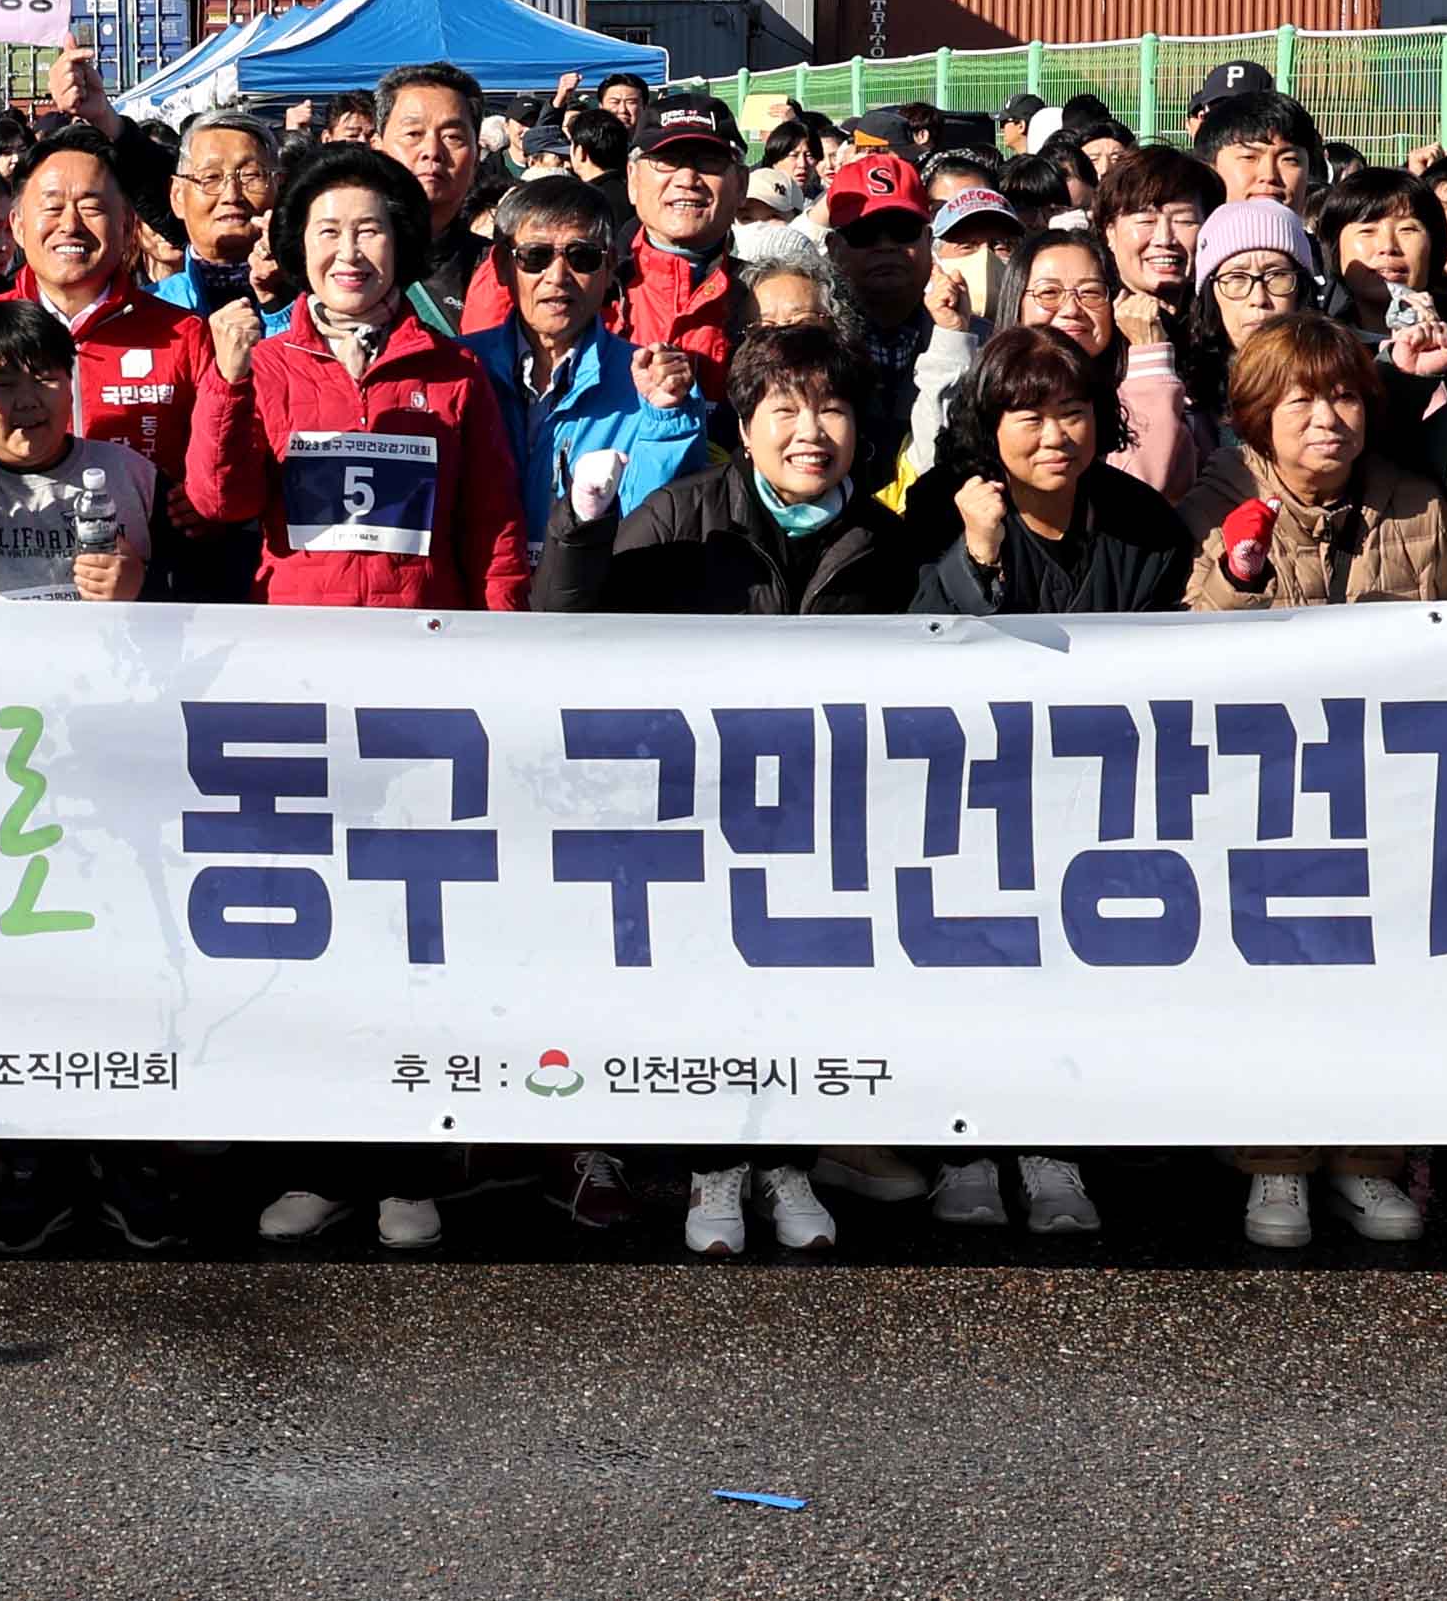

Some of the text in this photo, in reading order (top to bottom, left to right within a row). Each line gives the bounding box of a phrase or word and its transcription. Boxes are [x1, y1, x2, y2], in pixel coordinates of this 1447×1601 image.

[1227, 65, 1244, 88] P
[867, 166, 896, 196] S
[100, 383, 175, 406] 국민의힘
[290, 439, 320, 451] 2023
[342, 465, 375, 517] 5
[180, 700, 500, 965] 동구
[603, 1056, 799, 1096] 인천광역시
[813, 1057, 894, 1096] 동구
